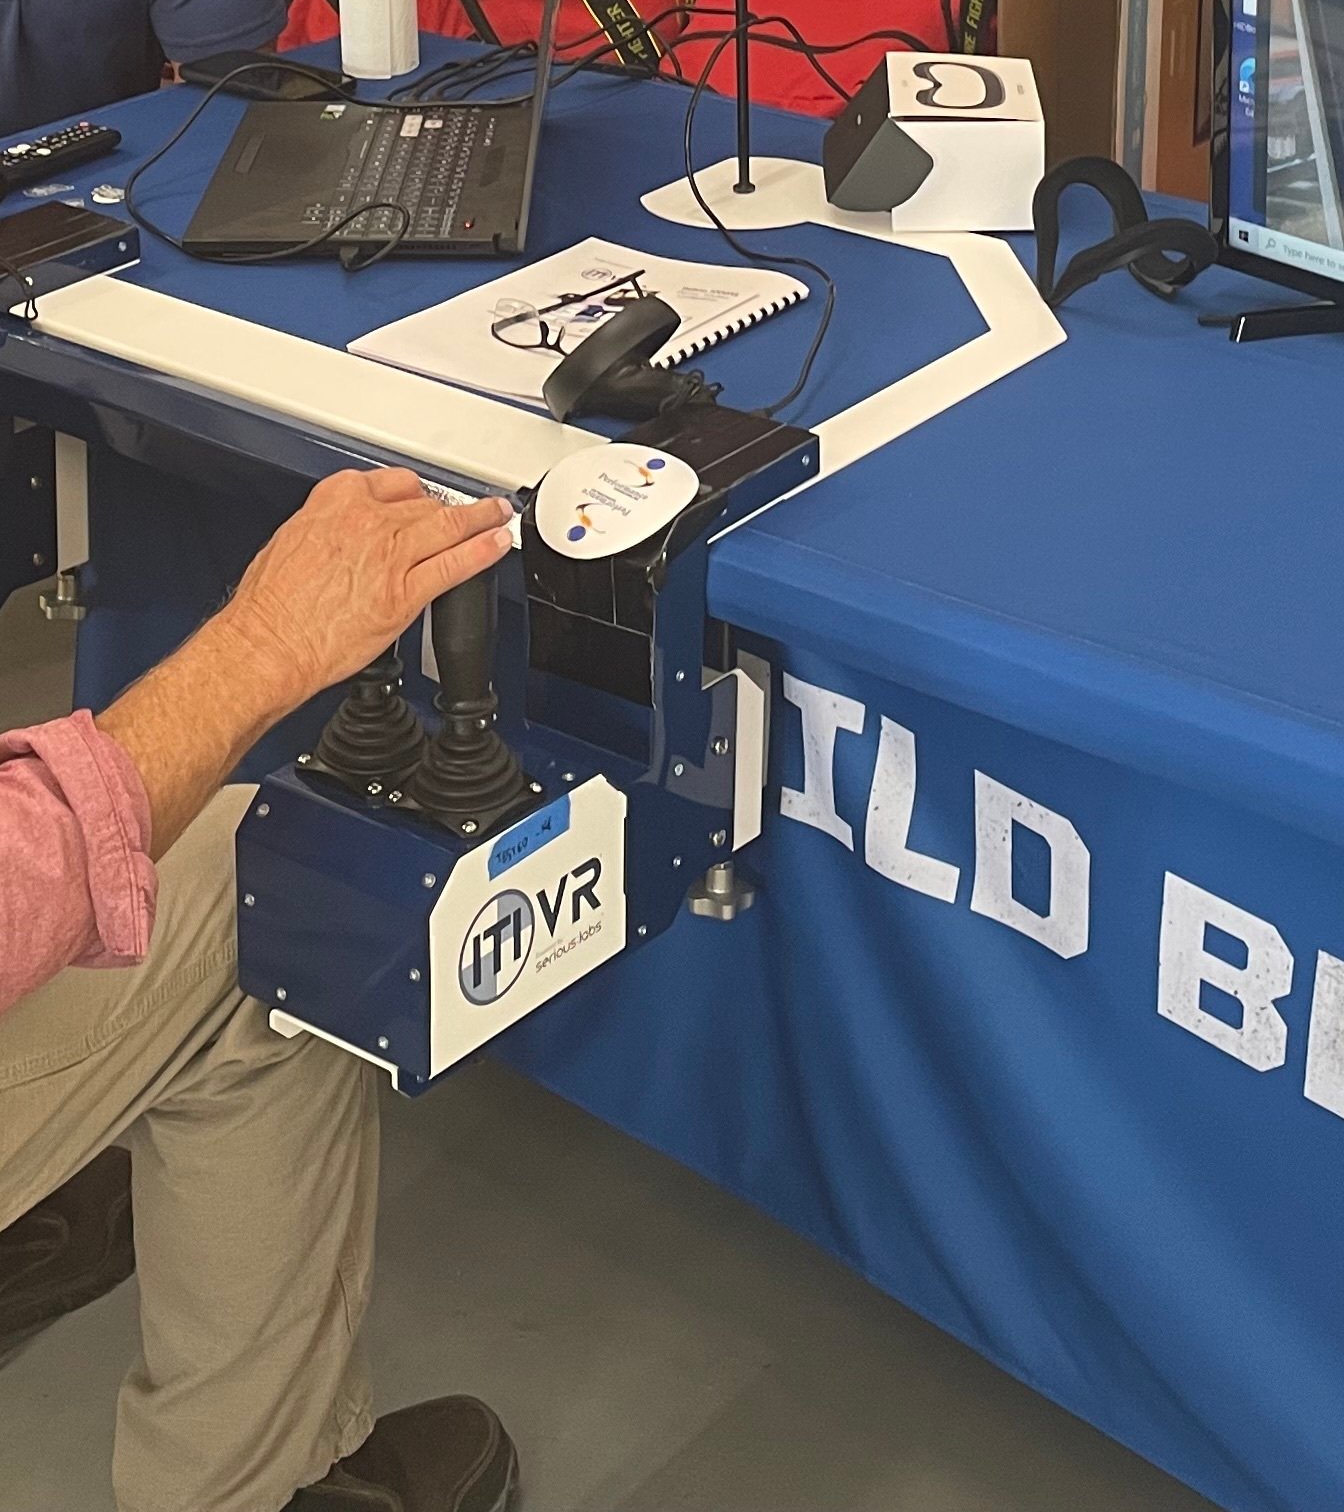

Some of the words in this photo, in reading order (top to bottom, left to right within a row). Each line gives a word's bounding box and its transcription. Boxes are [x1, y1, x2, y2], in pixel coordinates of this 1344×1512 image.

[1283, 245, 1303, 261] Type
[1304, 248, 1325, 265] here
[1327, 258, 1337, 269] to
[472, 907, 522, 989] ITI
[536, 856, 602, 938] VR
